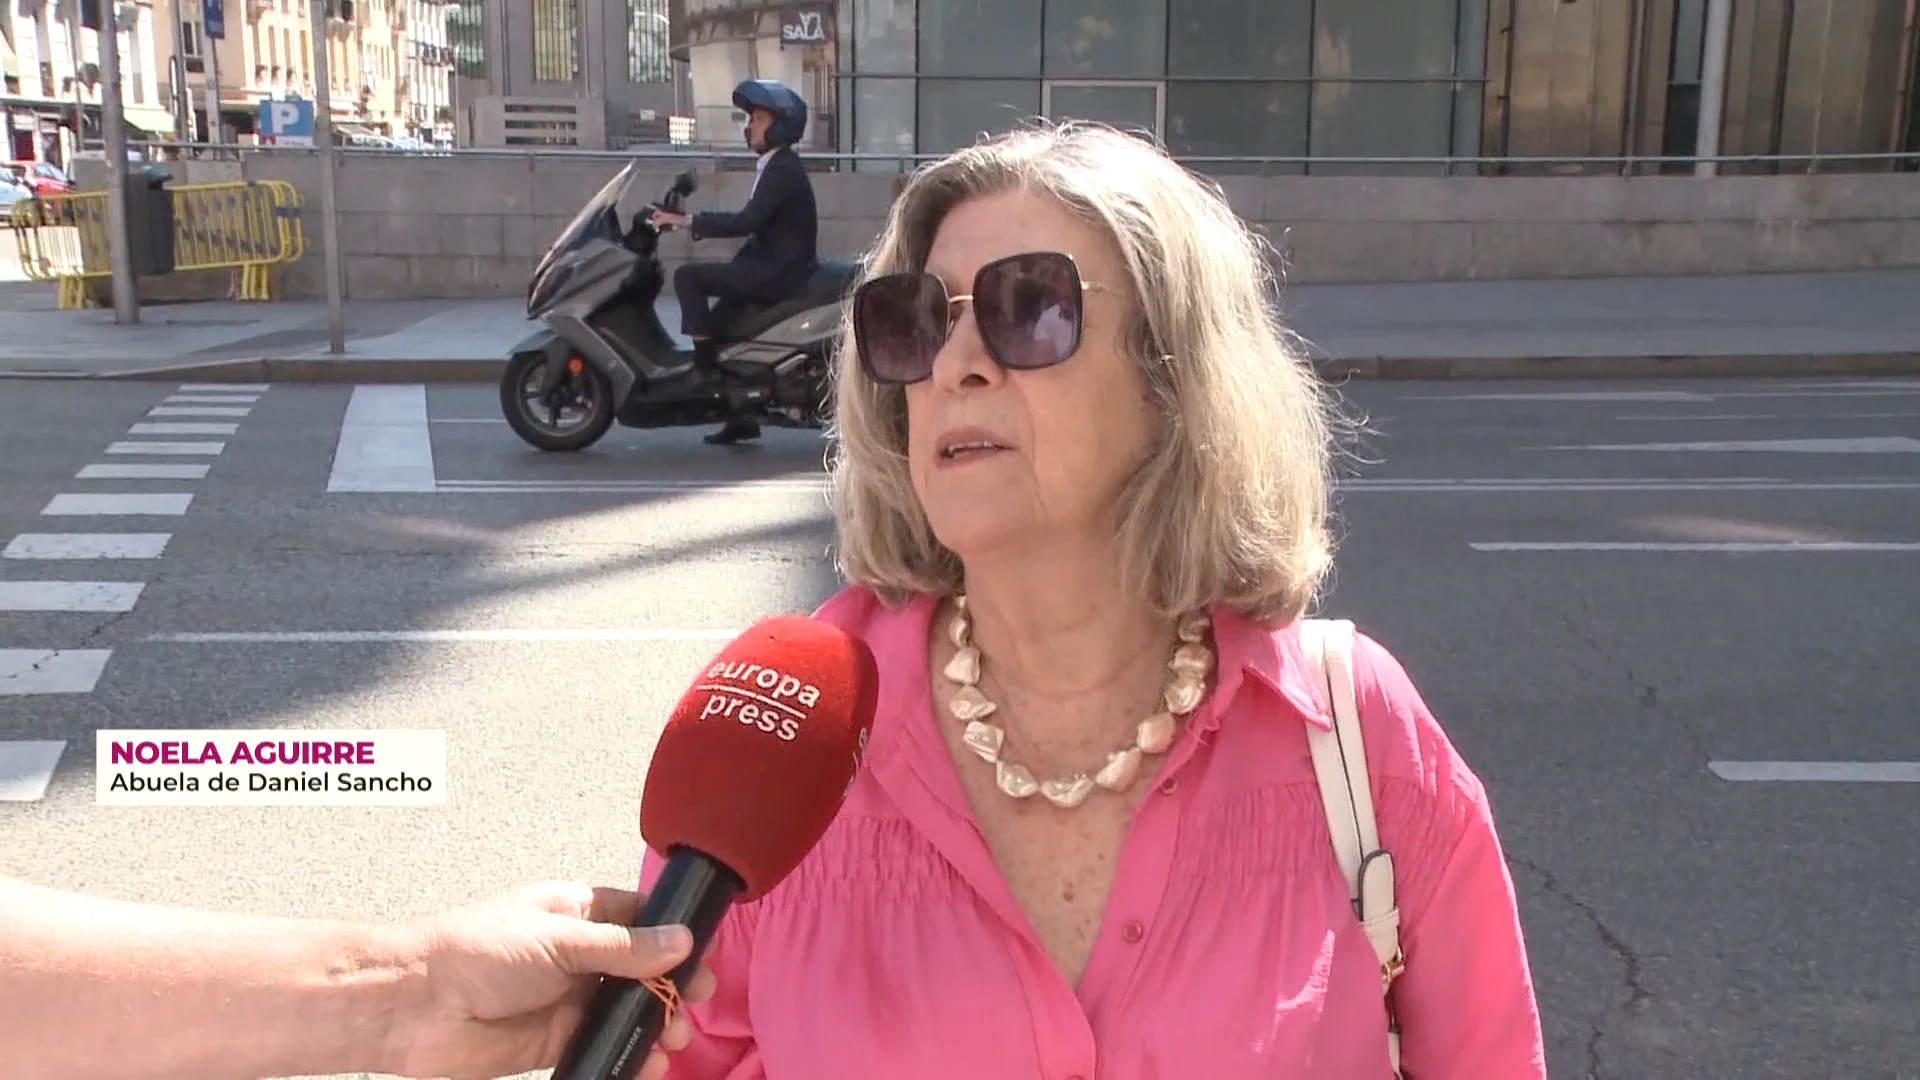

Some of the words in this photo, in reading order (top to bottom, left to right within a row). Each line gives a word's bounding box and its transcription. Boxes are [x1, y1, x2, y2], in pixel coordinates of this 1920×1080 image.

[271, 102, 300, 134] P
[706, 660, 821, 709] europa
[700, 694, 799, 741] press
